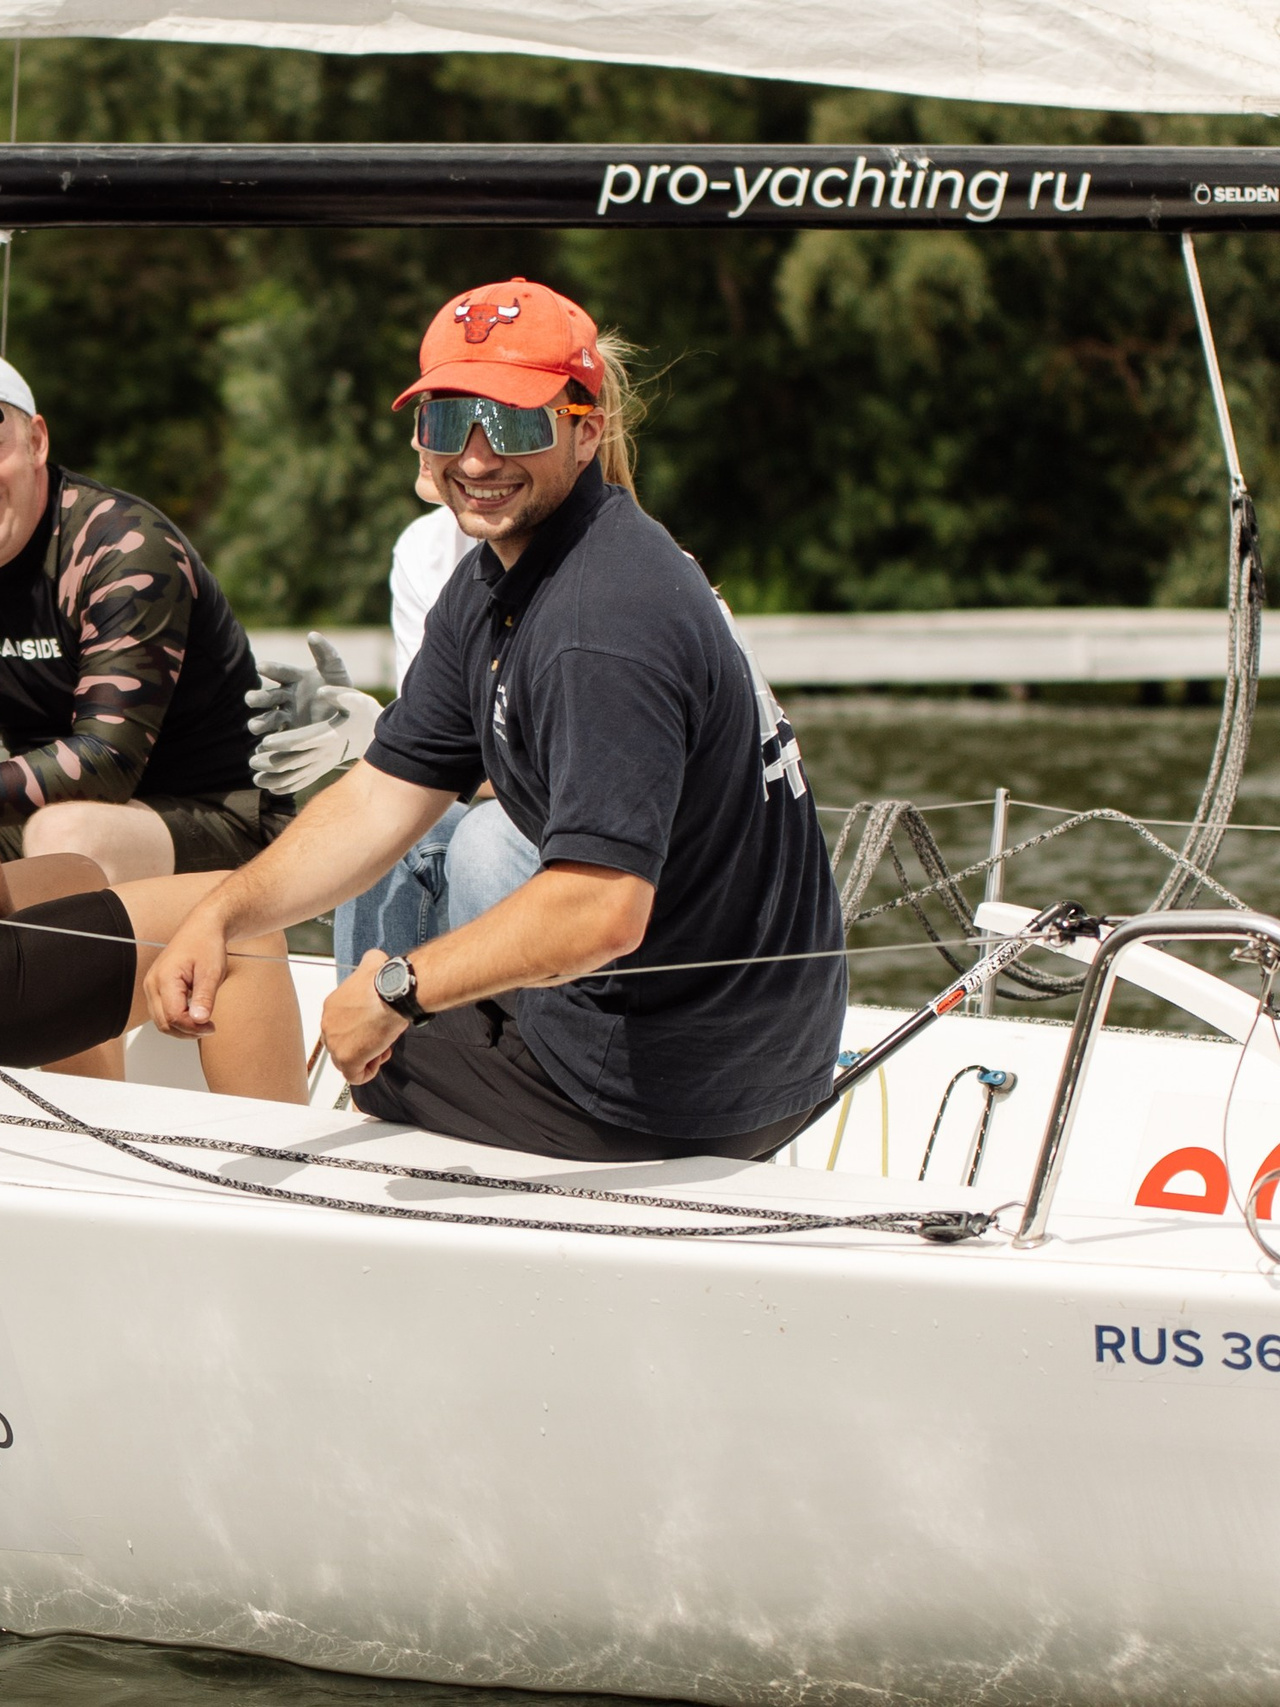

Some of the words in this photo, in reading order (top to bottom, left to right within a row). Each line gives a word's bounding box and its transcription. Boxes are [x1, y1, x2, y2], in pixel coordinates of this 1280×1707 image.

[598, 156, 1009, 222] pro-yachting
[1029, 171, 1091, 212] ru
[1213, 184, 1280, 202] SELDÉN
[1094, 1324, 1204, 1368] RUS
